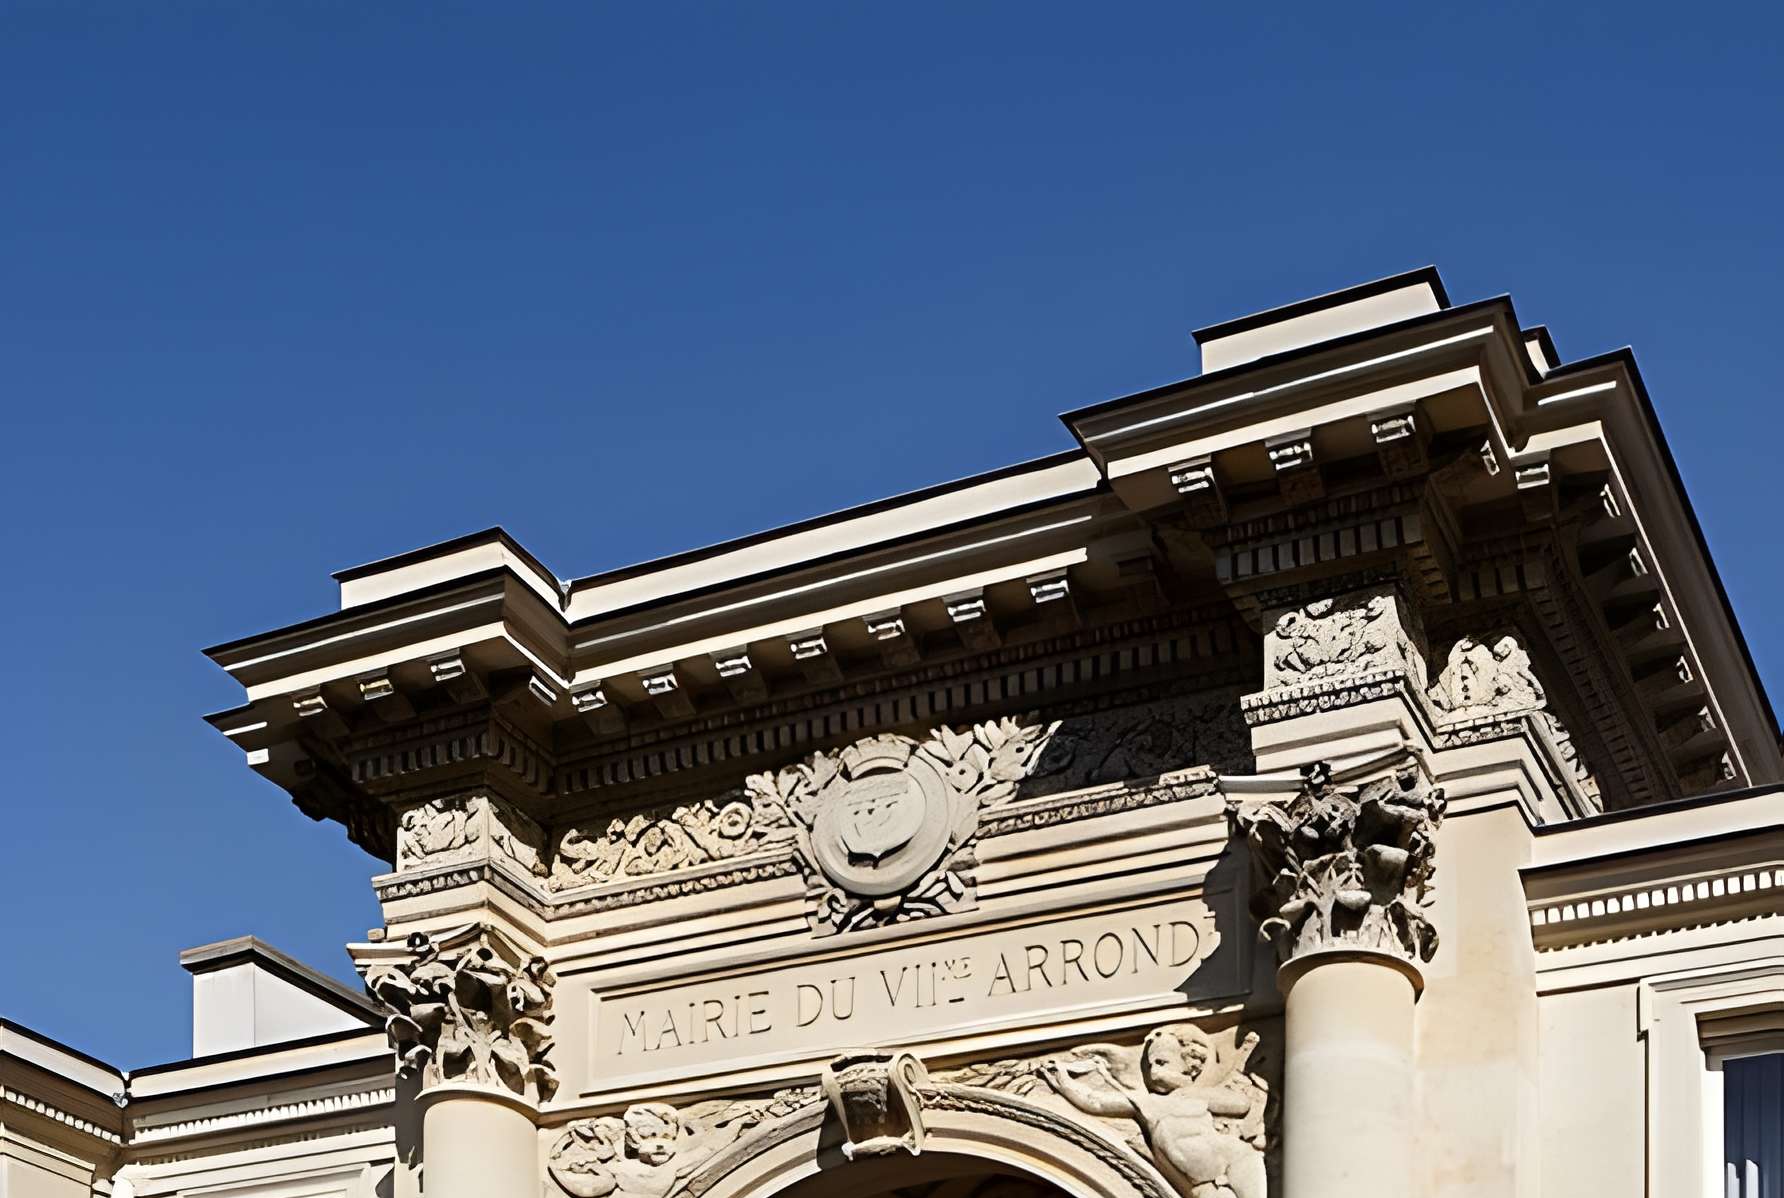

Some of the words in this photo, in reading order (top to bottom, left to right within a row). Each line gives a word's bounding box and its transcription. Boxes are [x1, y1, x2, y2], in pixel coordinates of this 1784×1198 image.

[617, 989, 773, 1056] MAIRIE
[796, 976, 857, 1028] DU
[987, 919, 1201, 998] ARROND
